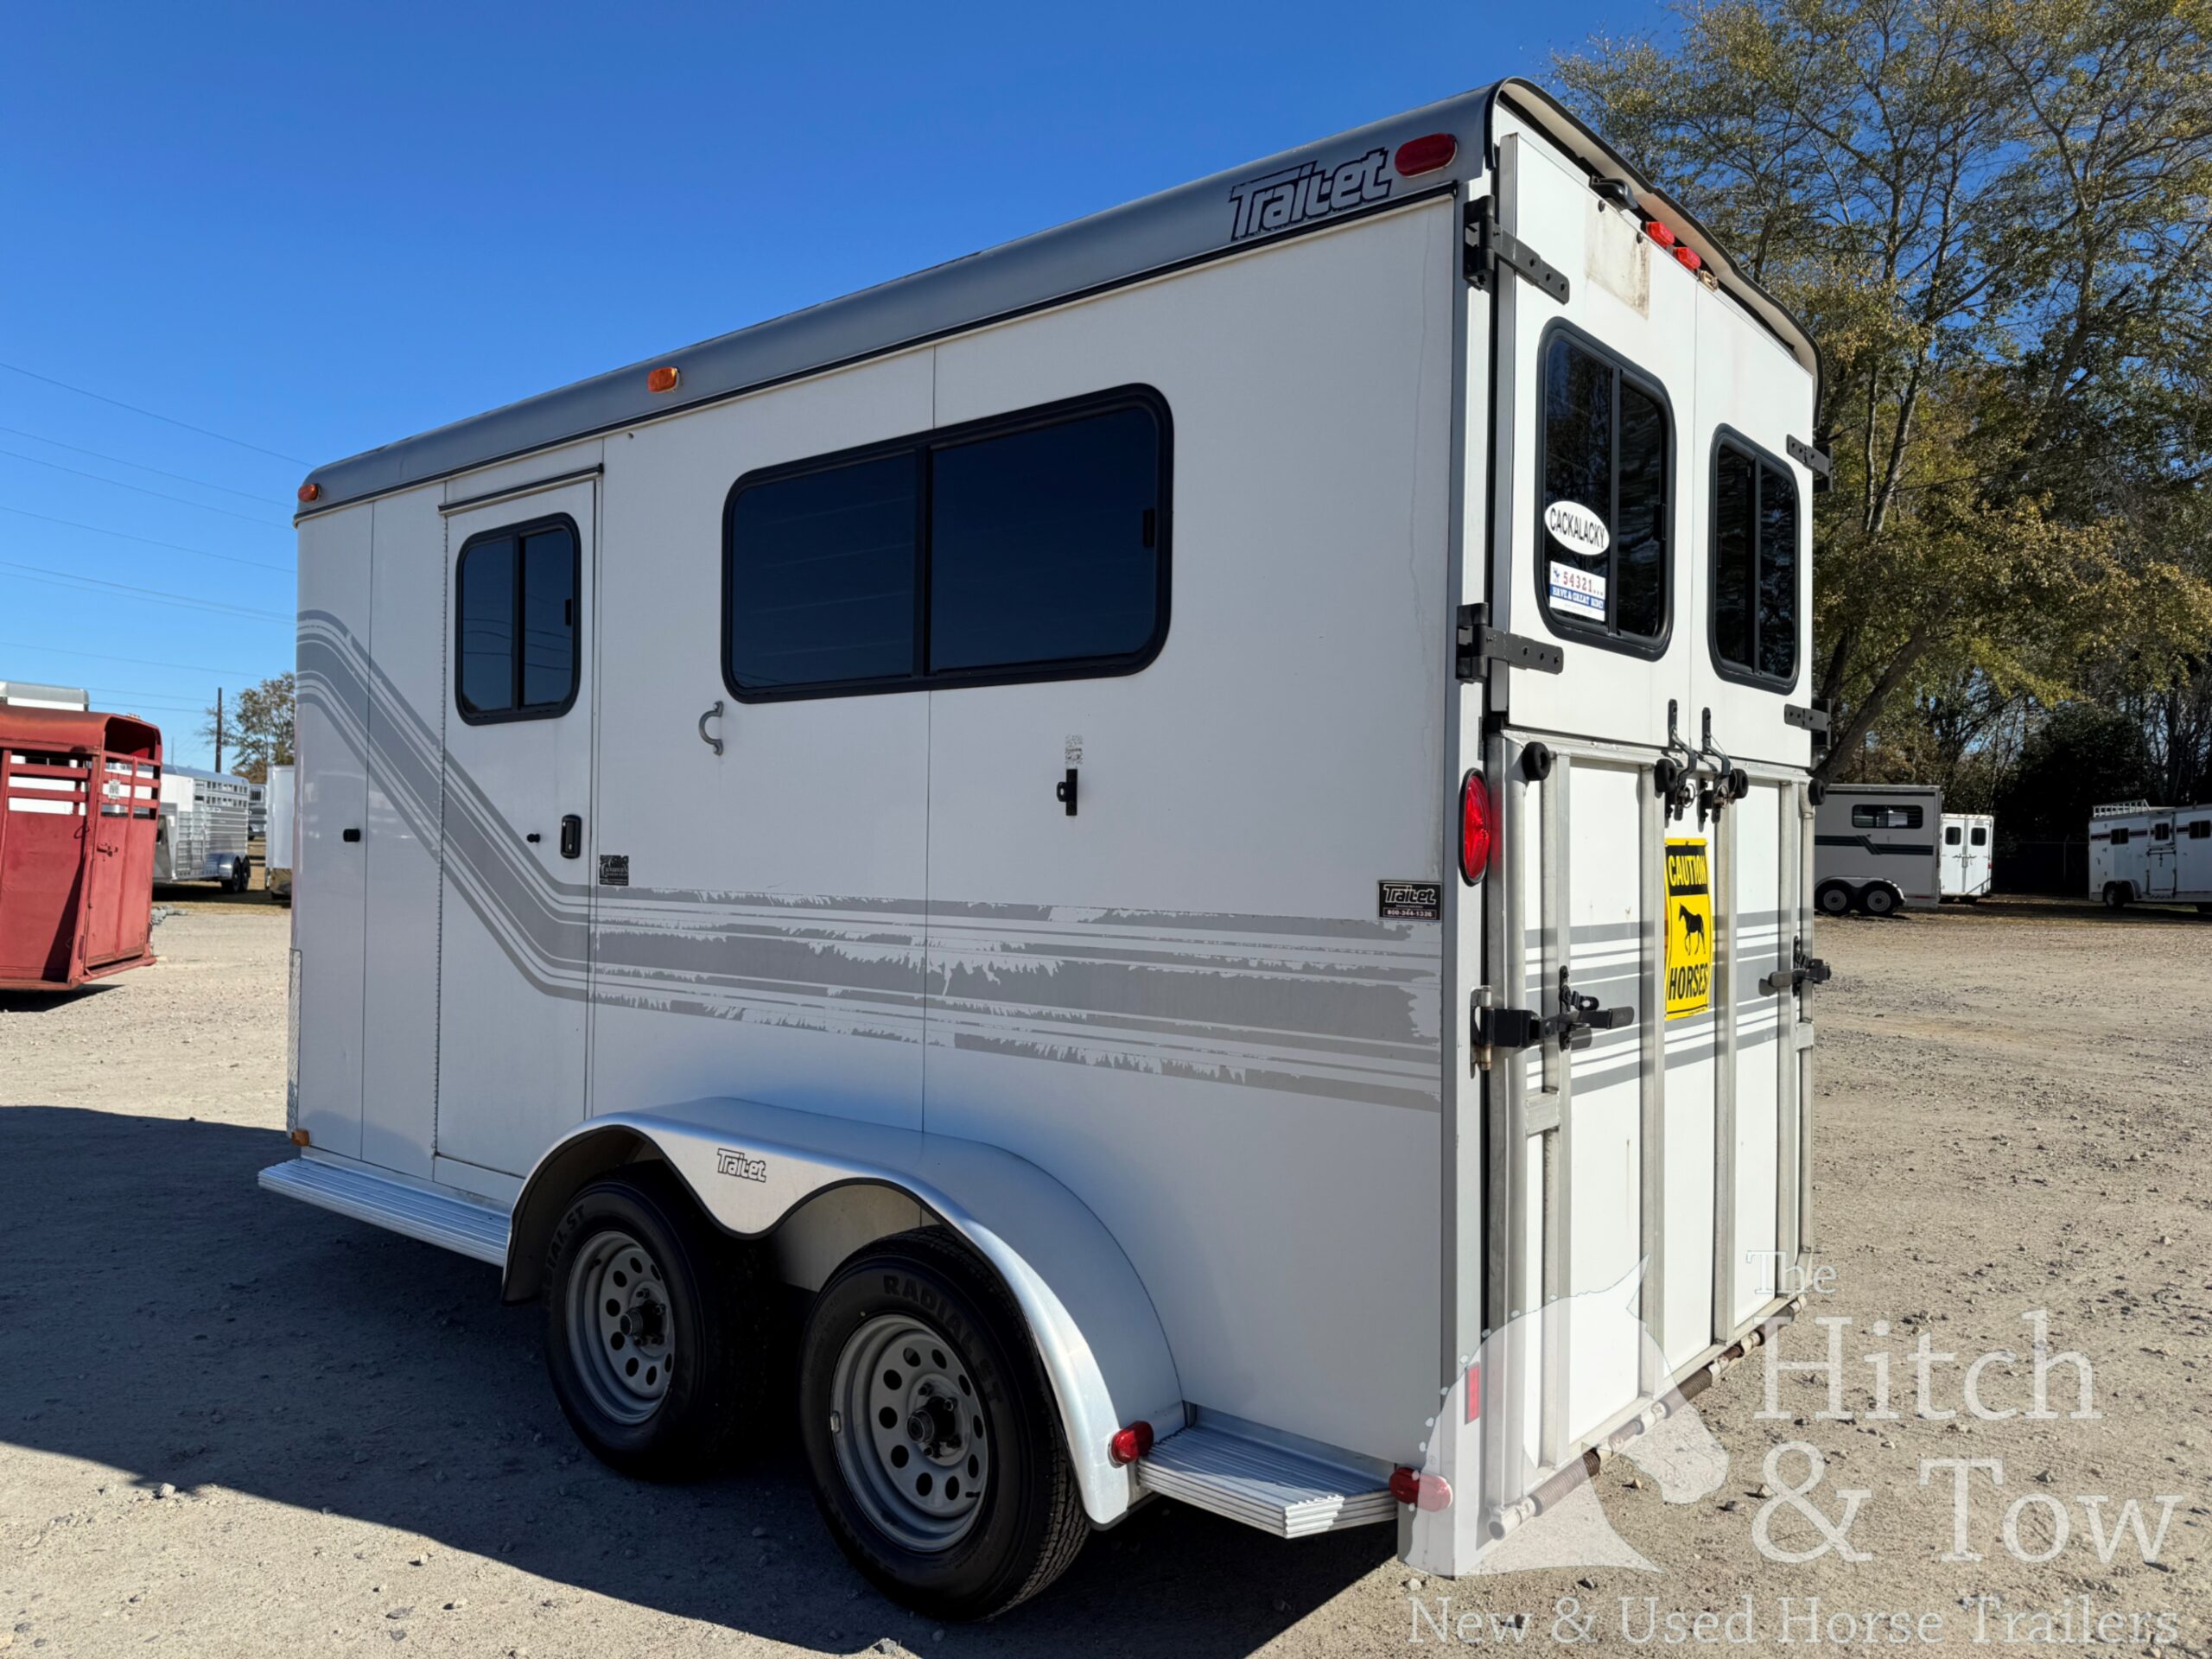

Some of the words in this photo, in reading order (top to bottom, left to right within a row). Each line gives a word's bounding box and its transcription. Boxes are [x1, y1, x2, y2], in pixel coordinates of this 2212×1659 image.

[1549, 507, 1605, 549] CACKALACKY
[1669, 855, 1707, 887] CAUTION
[1669, 963, 1708, 1001] HORSES
[883, 1274, 975, 1357] RADIAL
